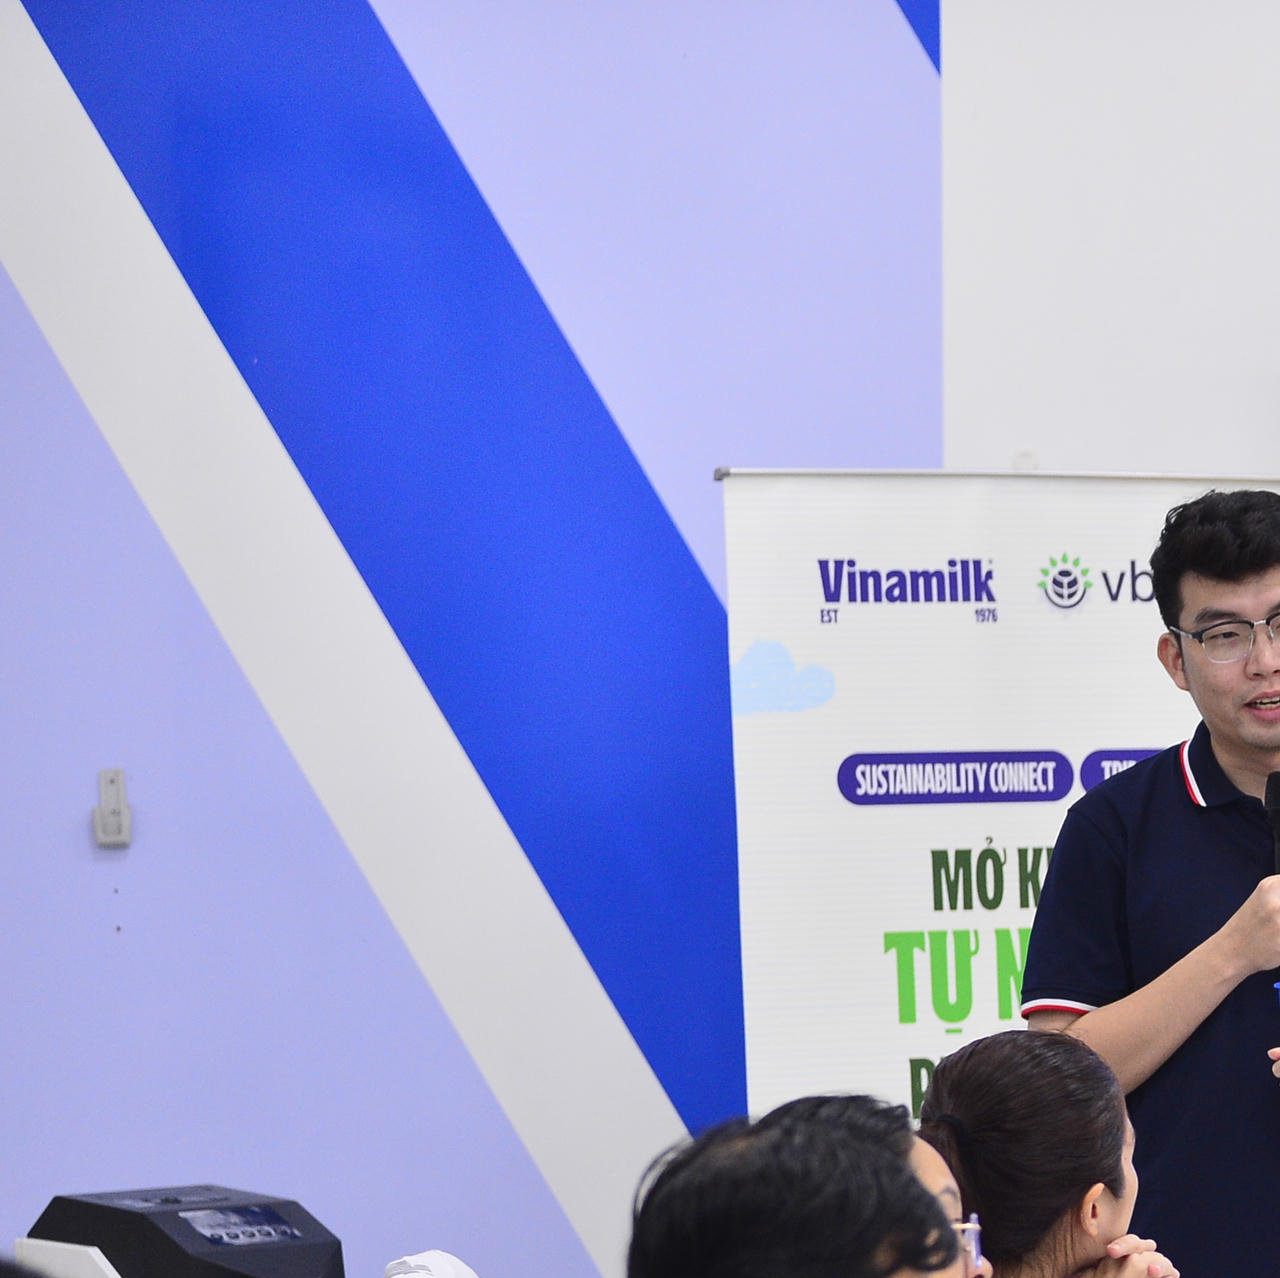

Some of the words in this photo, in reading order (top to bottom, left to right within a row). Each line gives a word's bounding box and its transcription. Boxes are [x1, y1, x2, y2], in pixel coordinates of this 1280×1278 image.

[817, 559, 997, 603] Vinamilk
[820, 609, 839, 624] EST
[974, 609, 998, 624] 1976
[855, 763, 989, 796] SUSTAINABILITY
[989, 761, 1057, 793] CONNECT
[930, 837, 1007, 912] MỞ
[884, 929, 980, 1034] TỰ
